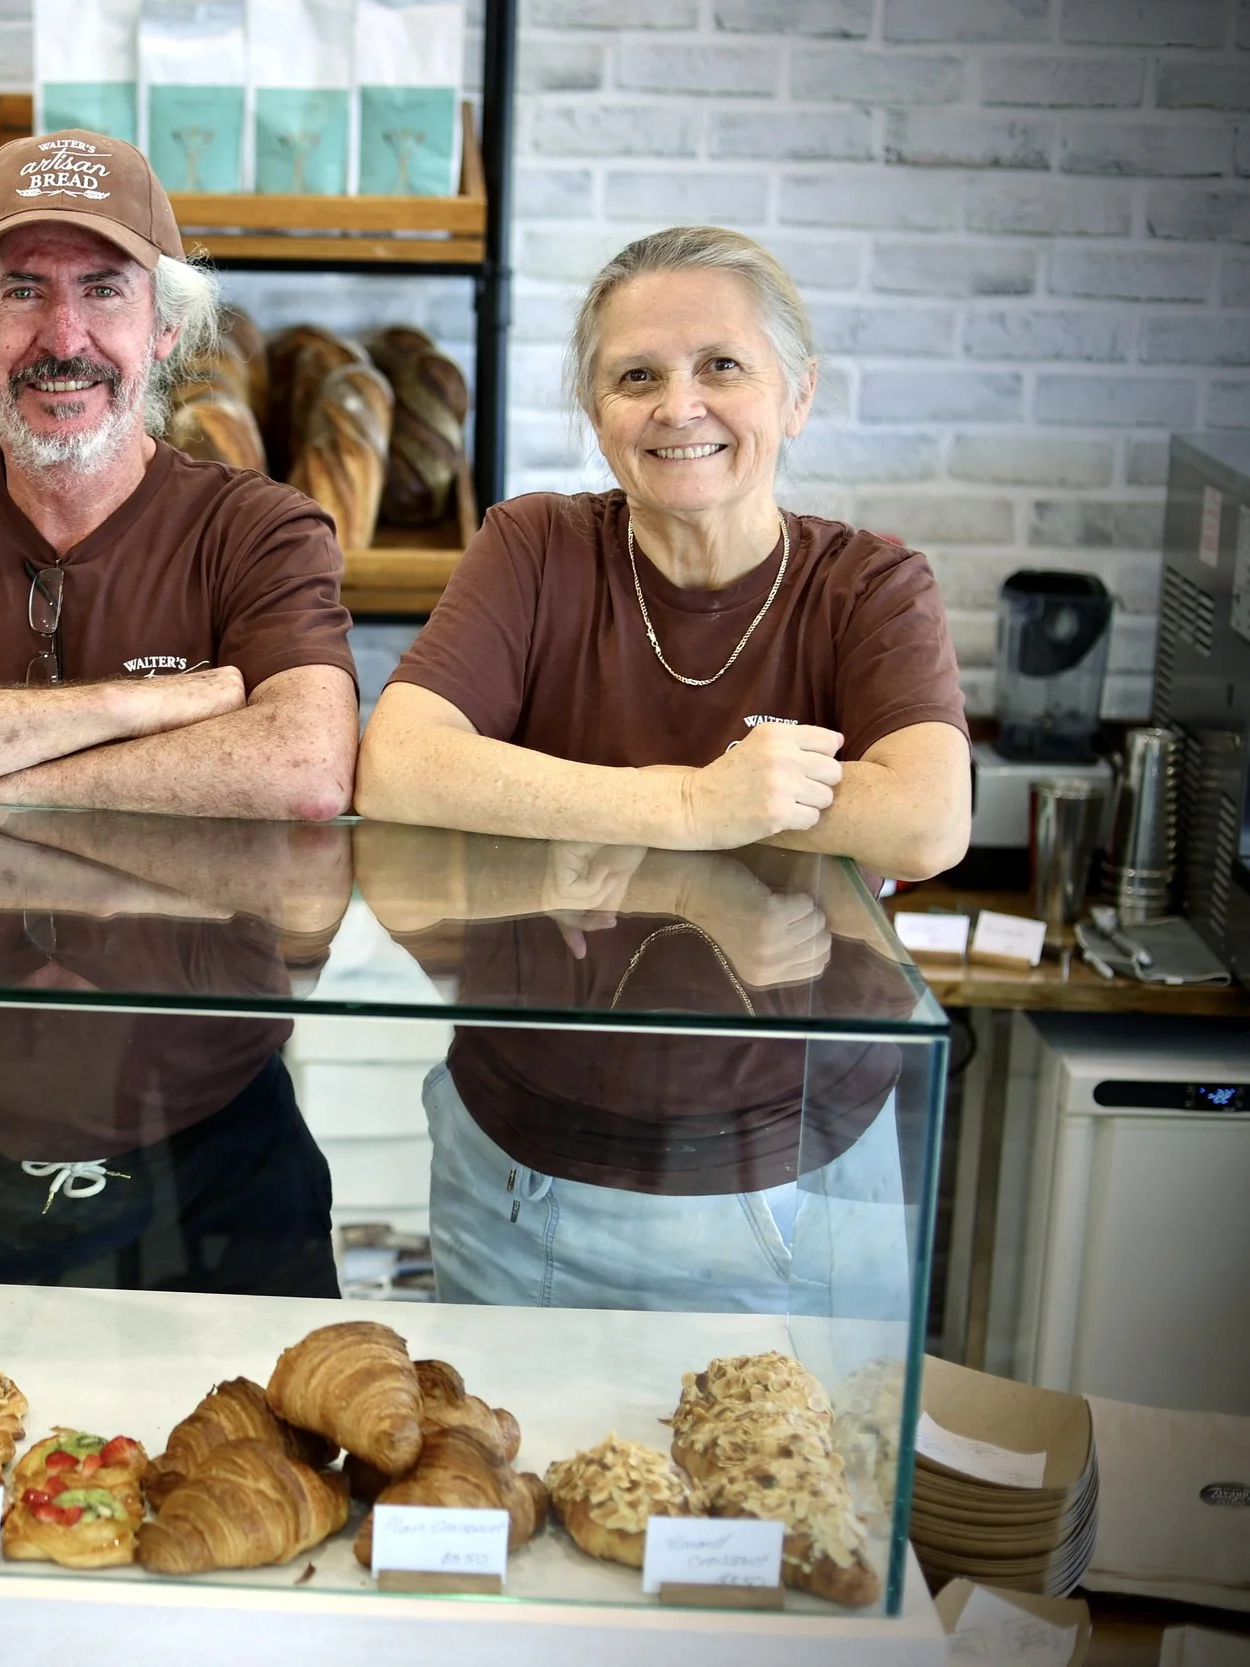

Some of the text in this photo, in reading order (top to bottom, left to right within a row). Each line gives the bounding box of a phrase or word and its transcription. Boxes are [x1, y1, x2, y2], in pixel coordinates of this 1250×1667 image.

[38, 140, 96, 154] WALTER'S
[20, 147, 112, 176] artisan
[30, 172, 98, 190] BREAD
[123, 656, 187, 672] WALTER'S
